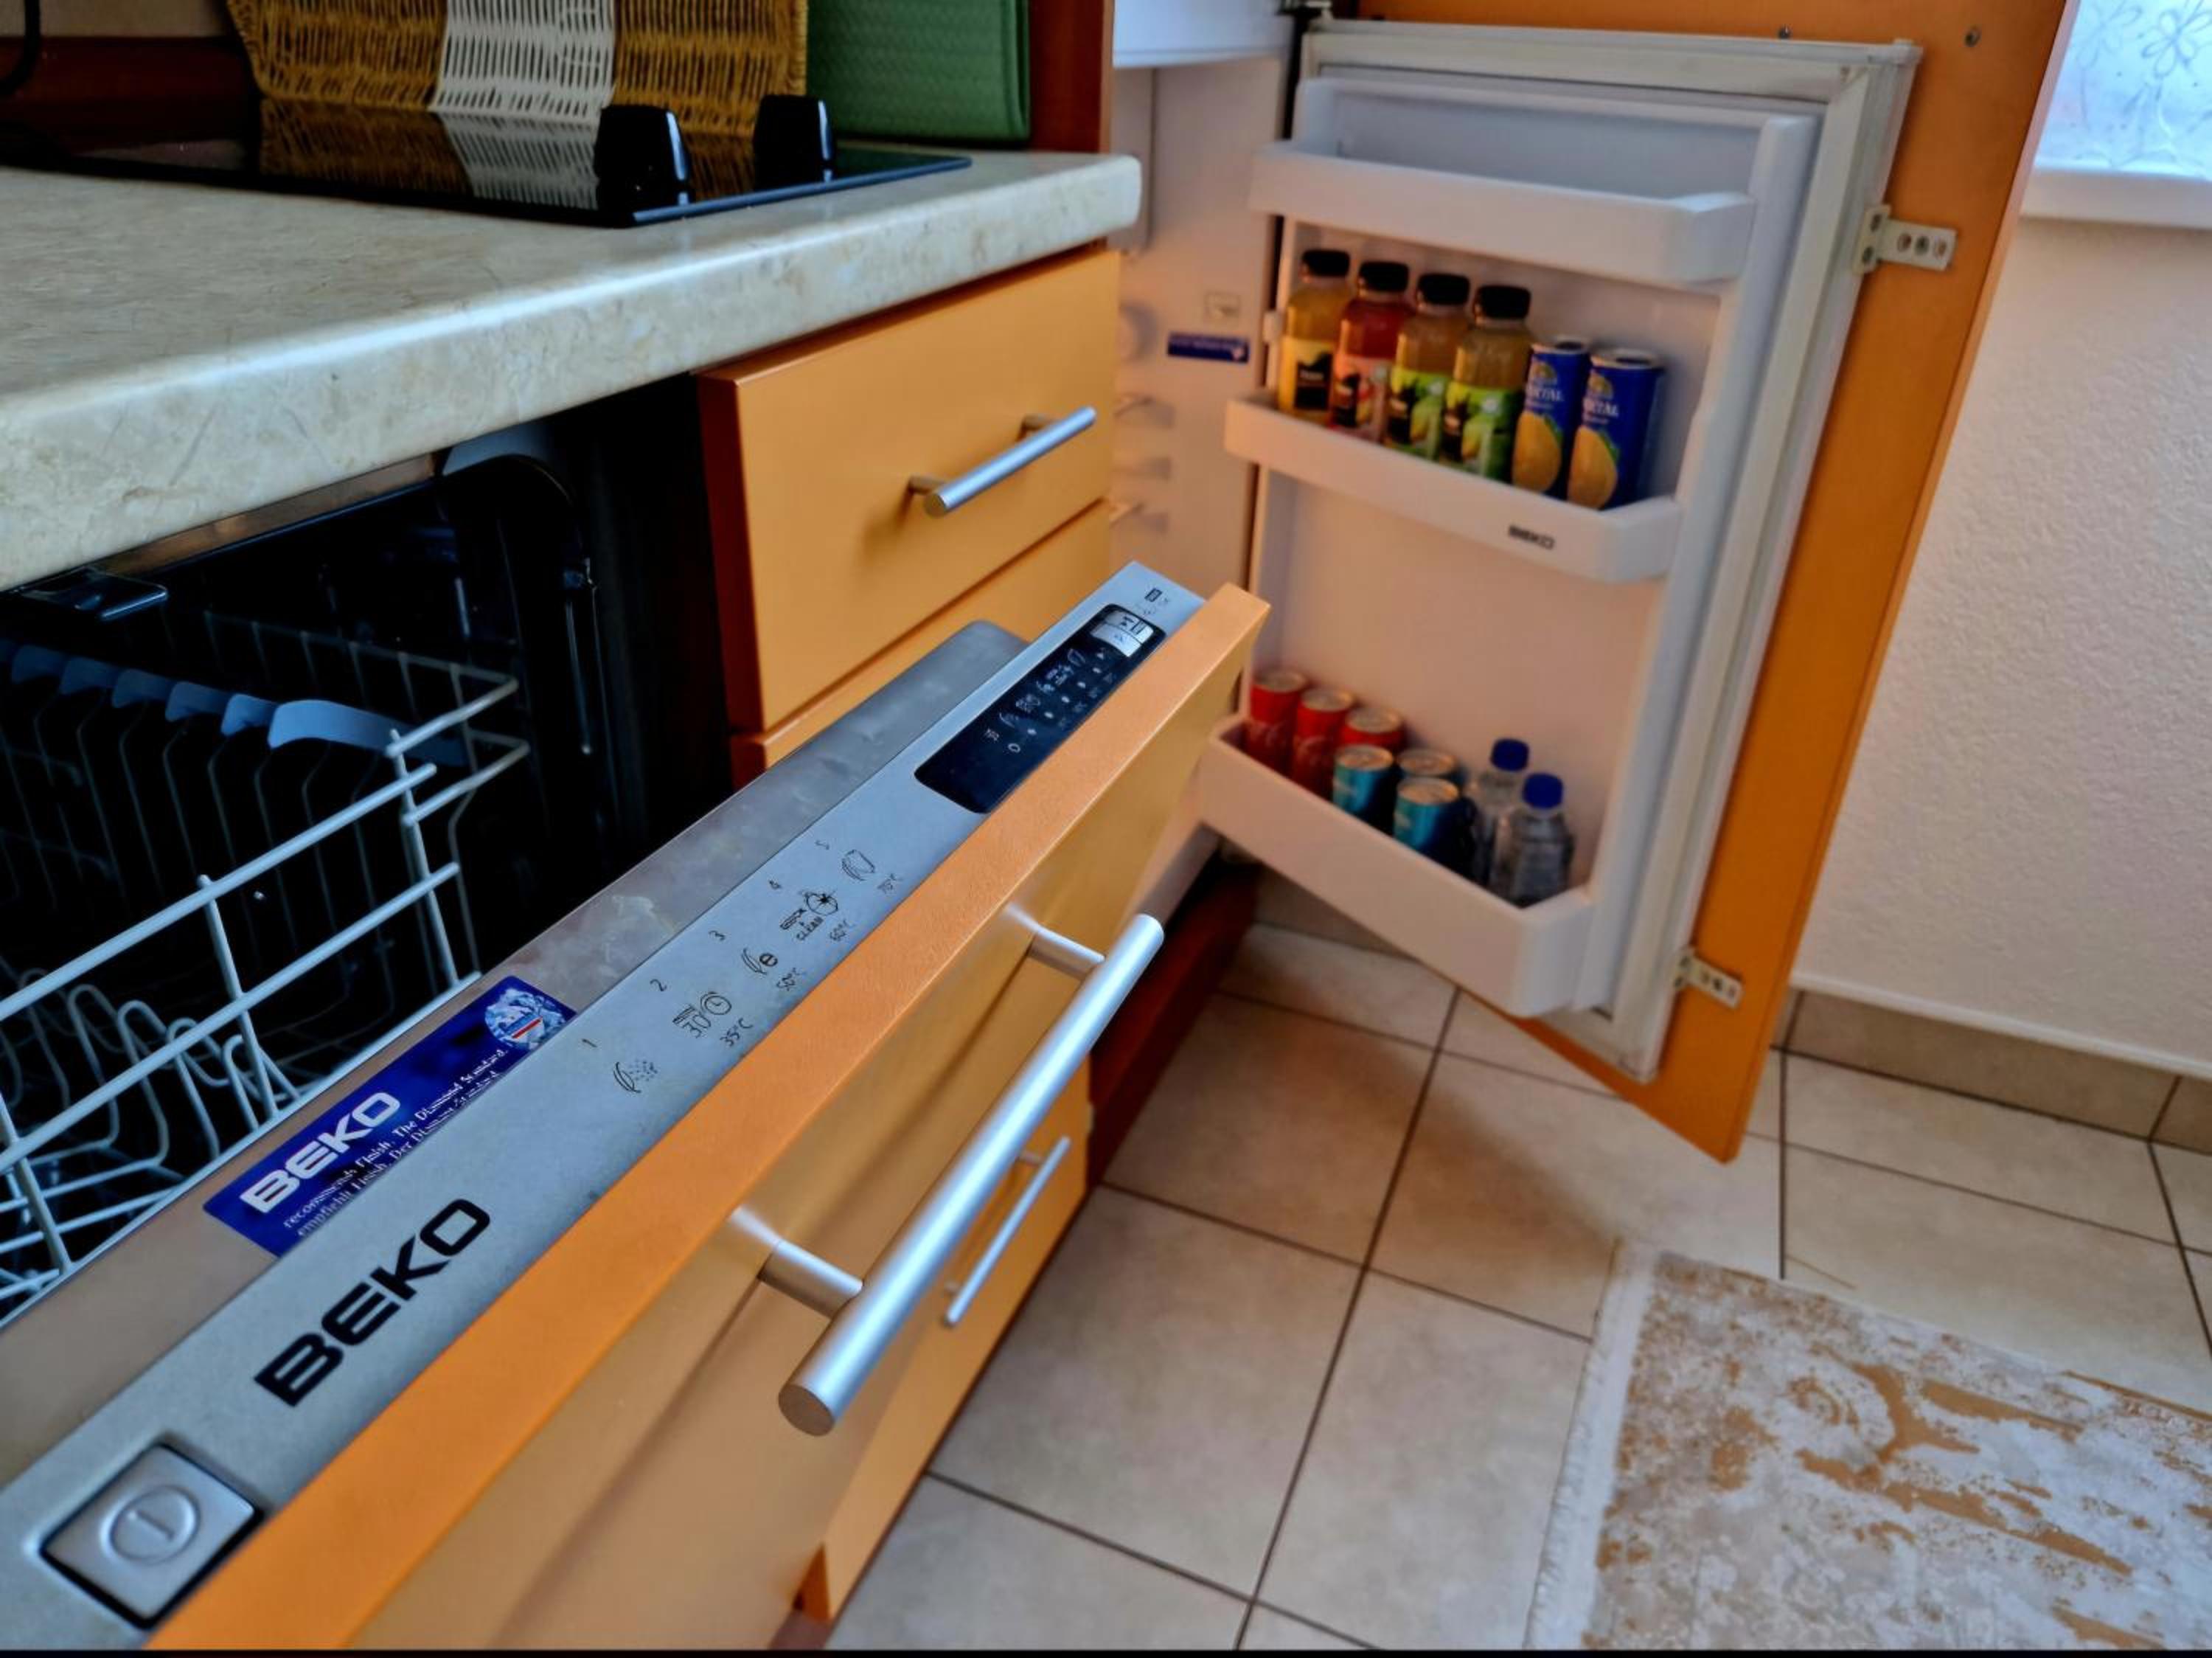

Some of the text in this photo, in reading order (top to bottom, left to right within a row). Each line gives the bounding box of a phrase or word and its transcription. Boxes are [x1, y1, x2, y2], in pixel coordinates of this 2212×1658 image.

[709, 929, 726, 941] 3
[650, 979, 668, 992] 2
[682, 1013, 712, 1038] 30
[582, 1038, 598, 1048] 1
[240, 1092, 401, 1214] BEKO
[253, 1199, 490, 1407] BEKO
